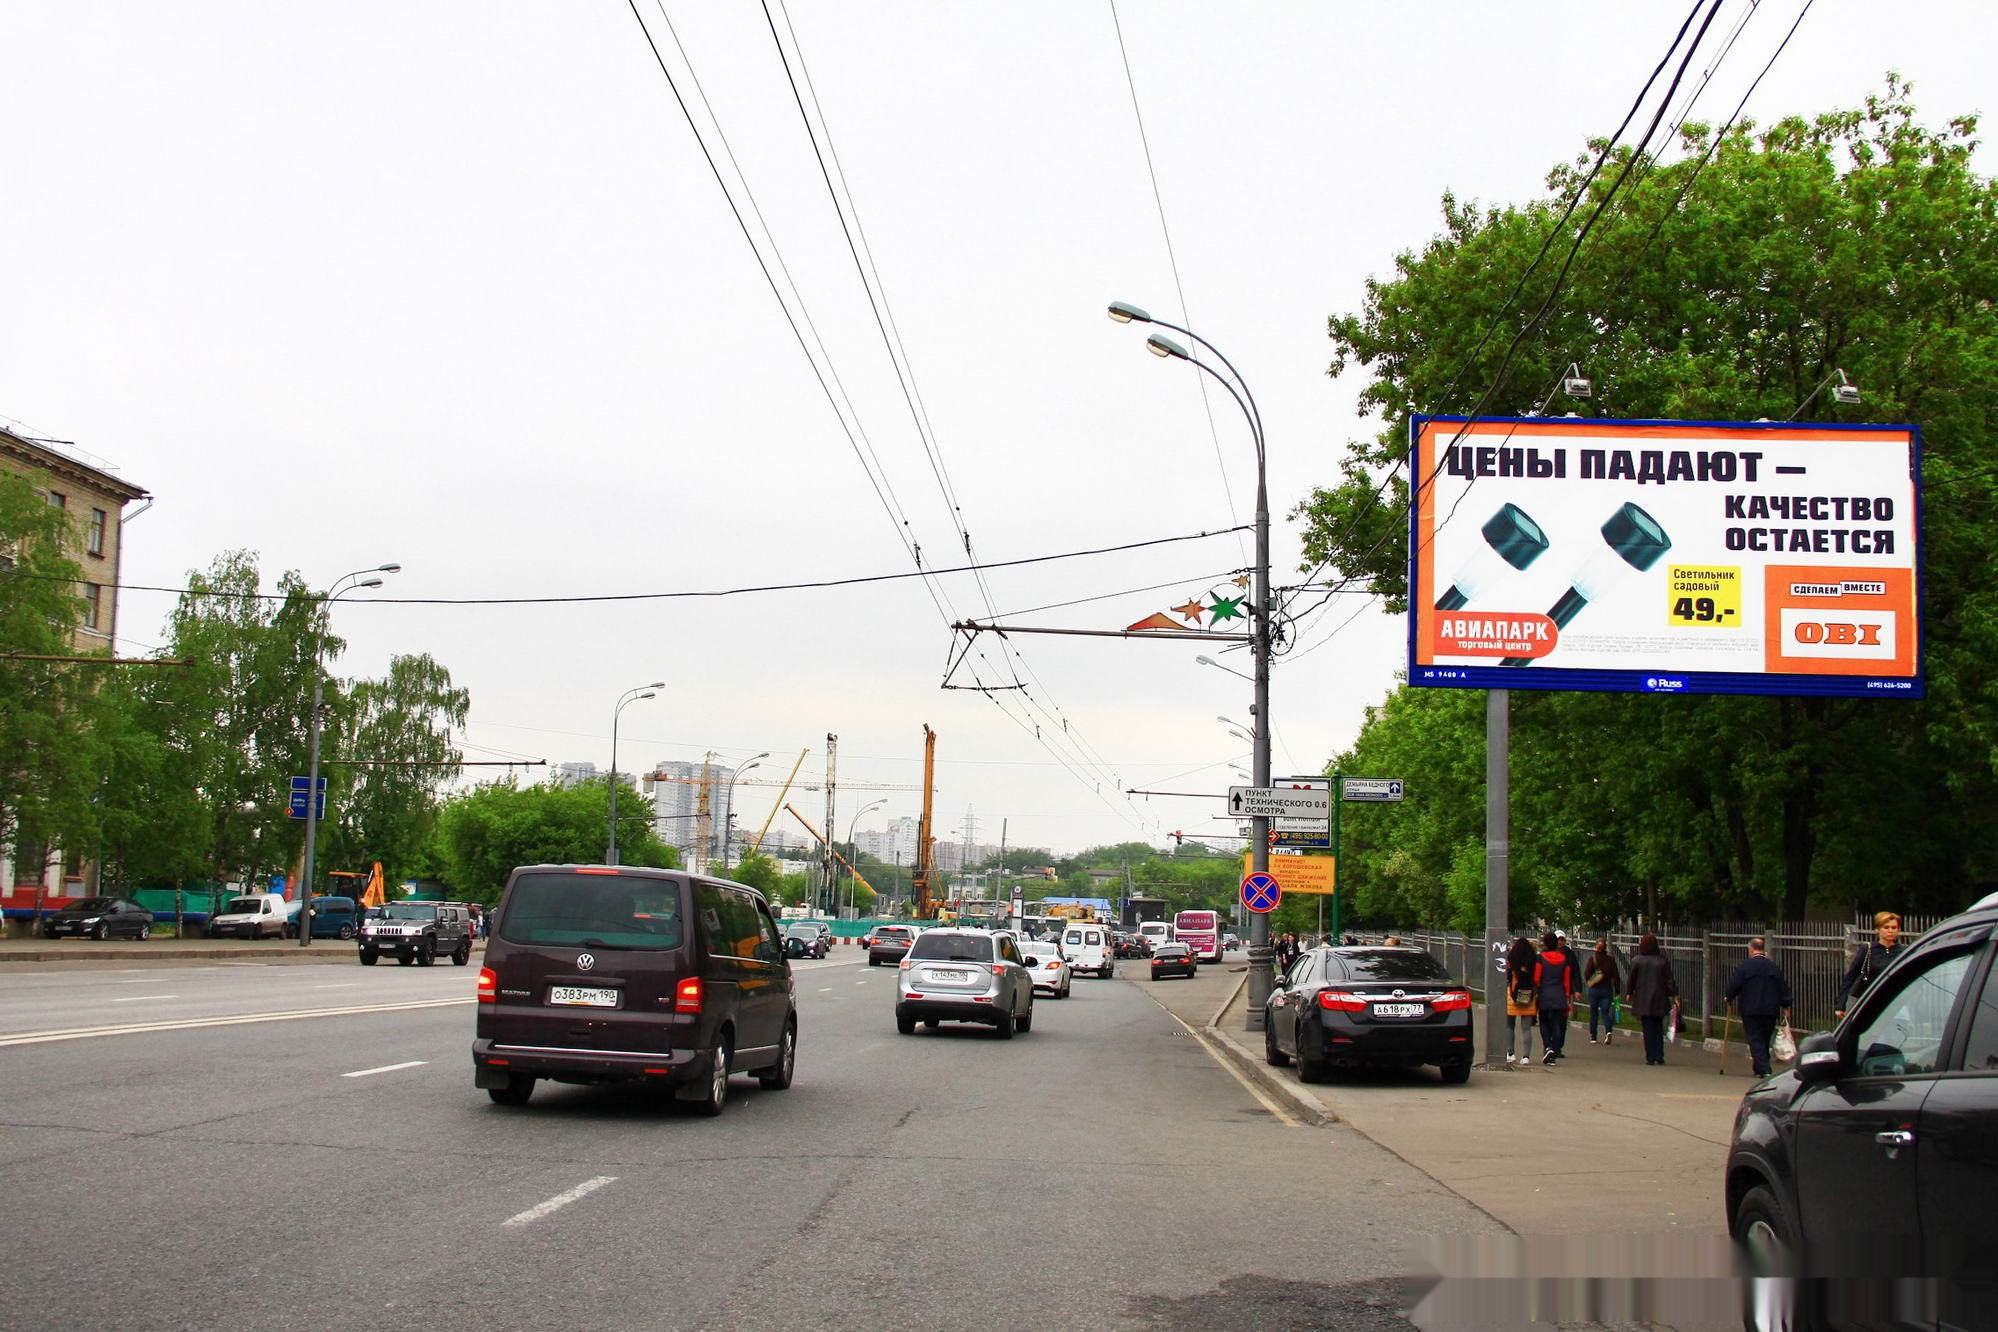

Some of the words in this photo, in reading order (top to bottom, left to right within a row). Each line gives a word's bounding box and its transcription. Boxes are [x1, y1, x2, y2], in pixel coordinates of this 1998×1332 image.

[1448, 447, 1566, 480] ЦЕНЫ
[1580, 449, 1763, 485] ПАДАЮТ
[1725, 495, 1894, 522] КАЧЕСТВО
[1725, 527, 1895, 554] ОСТАЕТСЯ
[1673, 568, 1735, 580] Светильник
[1673, 580, 1720, 592] садовый
[1793, 585, 1839, 595] СДЕЛАЕМ
[1843, 583, 1882, 593] ВМЕСТЕ
[1673, 597, 1735, 623] 49,-
[1440, 619, 1549, 641] АВИАПАРК
[1794, 622, 1882, 646] OBI
[1457, 640, 1503, 651] торговый
[1504, 641, 1532, 652] центр
[1658, 679, 1683, 688] Russ
[1245, 789, 1273, 797] ПУНКТ
[1245, 797, 1312, 808] ТЕХНИЧЕСКОГО
[1314, 801, 1328, 809] 0.6
[1244, 806, 1286, 815] ОСМОТРА
[554, 989, 597, 1001] О383РМ
[599, 990, 615, 999] 190
[1377, 1005, 1410, 1014] А618РХ
